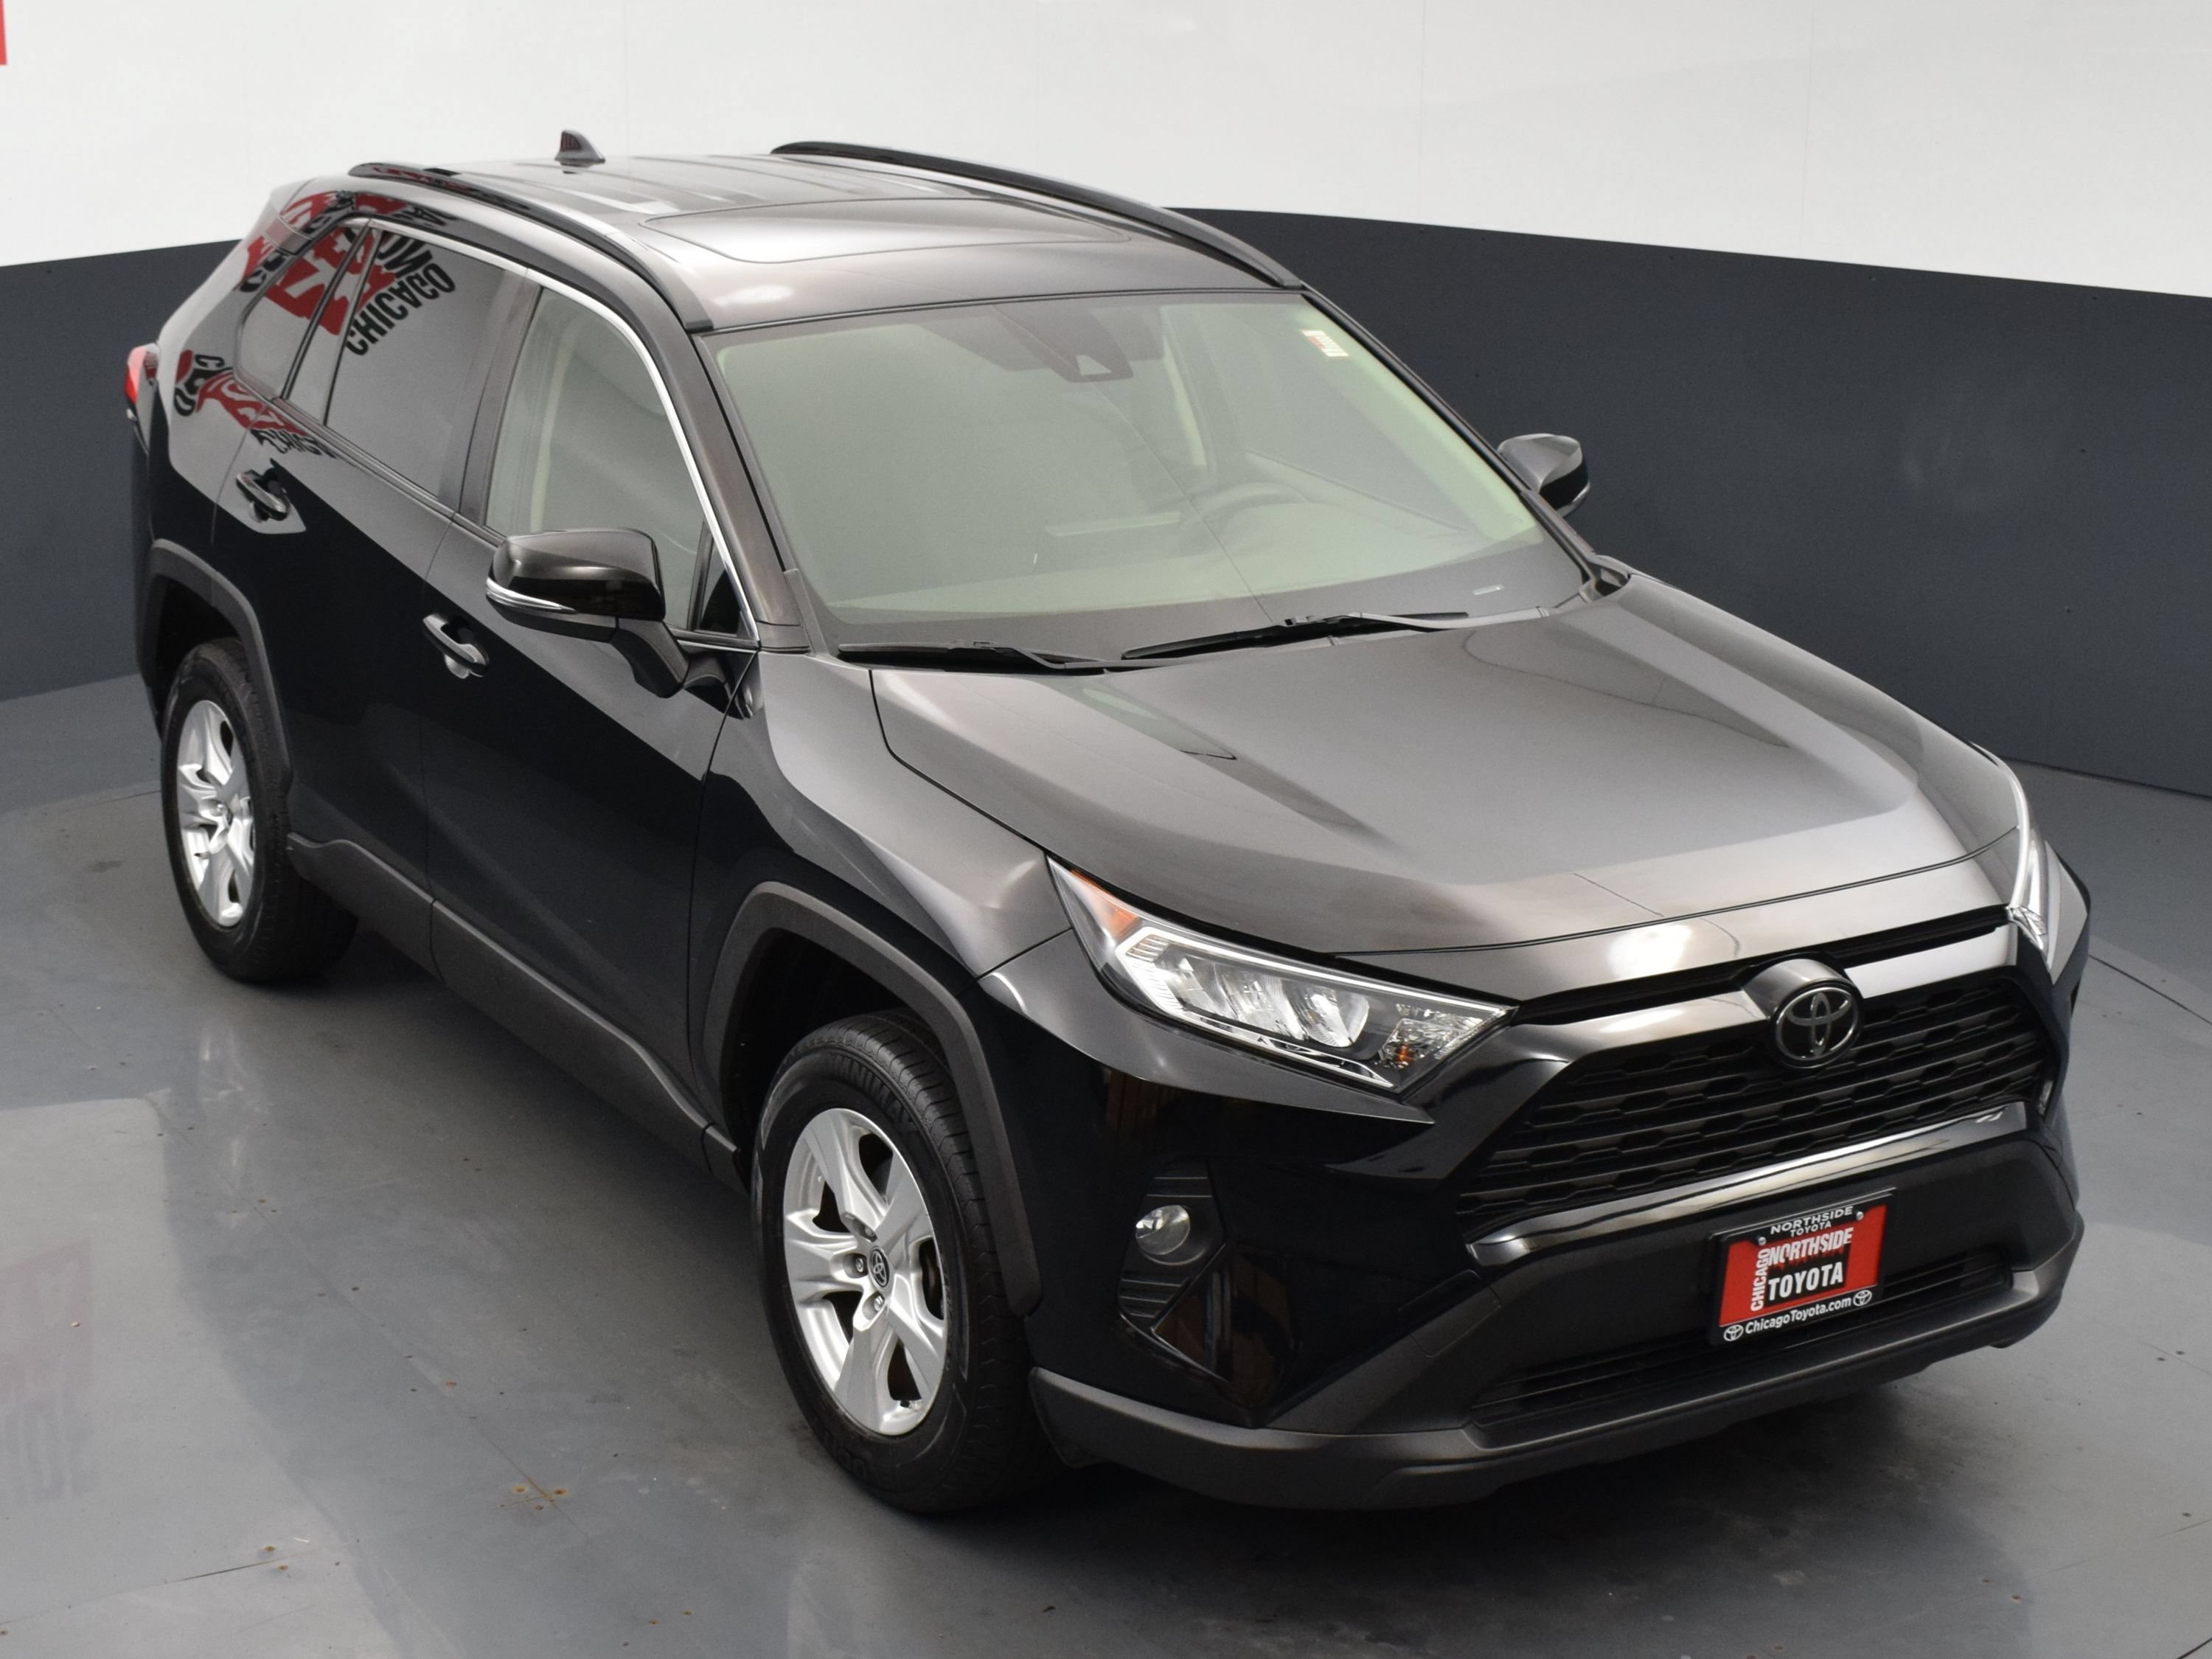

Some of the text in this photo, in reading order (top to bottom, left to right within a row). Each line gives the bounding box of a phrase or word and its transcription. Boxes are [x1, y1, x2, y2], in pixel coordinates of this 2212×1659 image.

[1770, 1206, 1854, 1234] NORTHSIDE
[1790, 1220, 1832, 1237] TOYOTA
[1767, 1227, 1854, 1266] NORTHSIDE
[1750, 1248, 1770, 1312] CHICAGO
[1768, 1262, 1843, 1301] TOYOTA
[1745, 1296, 1851, 1334] ChicagoToyota.com
